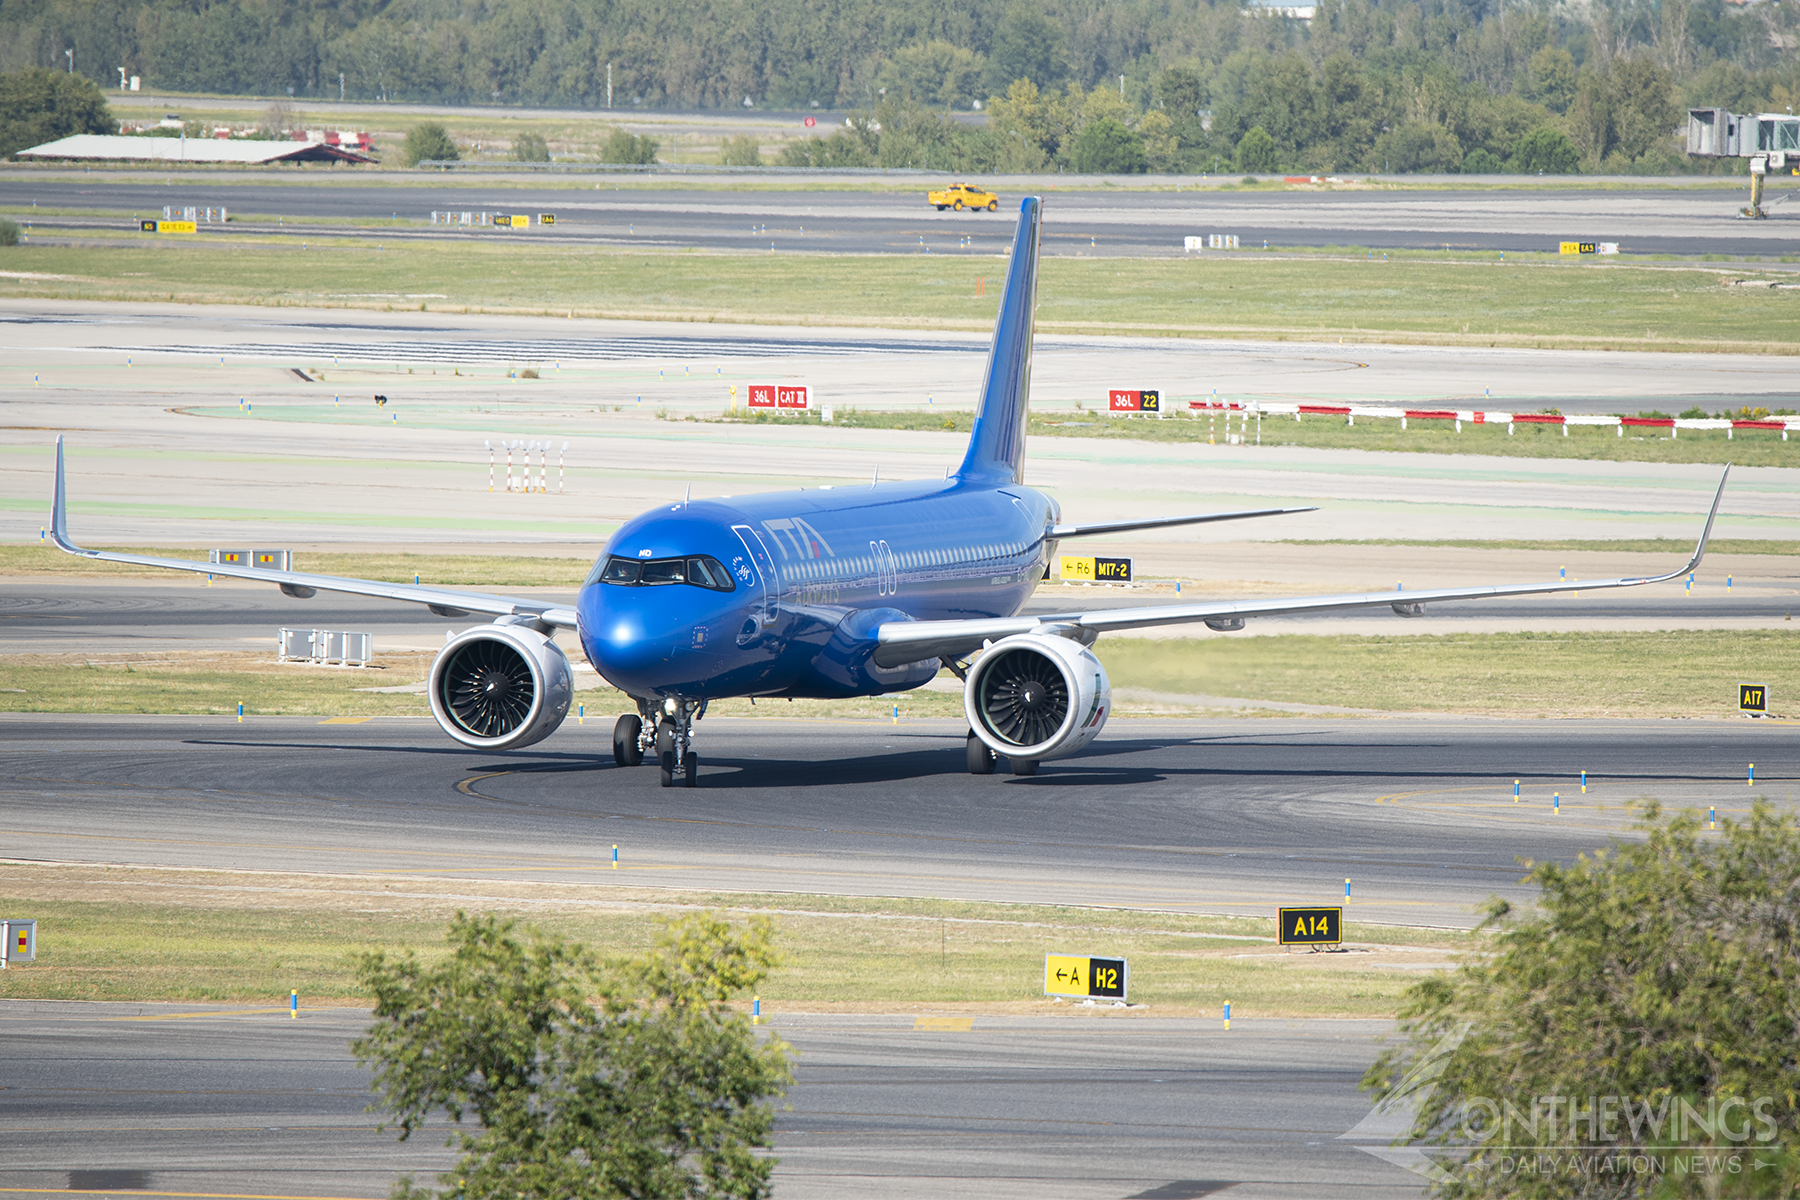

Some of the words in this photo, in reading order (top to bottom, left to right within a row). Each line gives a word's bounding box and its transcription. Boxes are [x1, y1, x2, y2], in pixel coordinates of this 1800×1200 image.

[754, 390, 770, 403] 36L
[780, 391, 795, 404] CAT
[1115, 394, 1134, 407] 36L
[1143, 394, 1157, 408] Z2
[761, 517, 835, 560] ITA
[1077, 562, 1090, 575] R6
[1098, 562, 1127, 577] M17-2
[1743, 690, 1762, 706] A17
[1294, 916, 1328, 936] A14
[1070, 967, 1080, 985] A
[1096, 967, 1117, 989] H2
